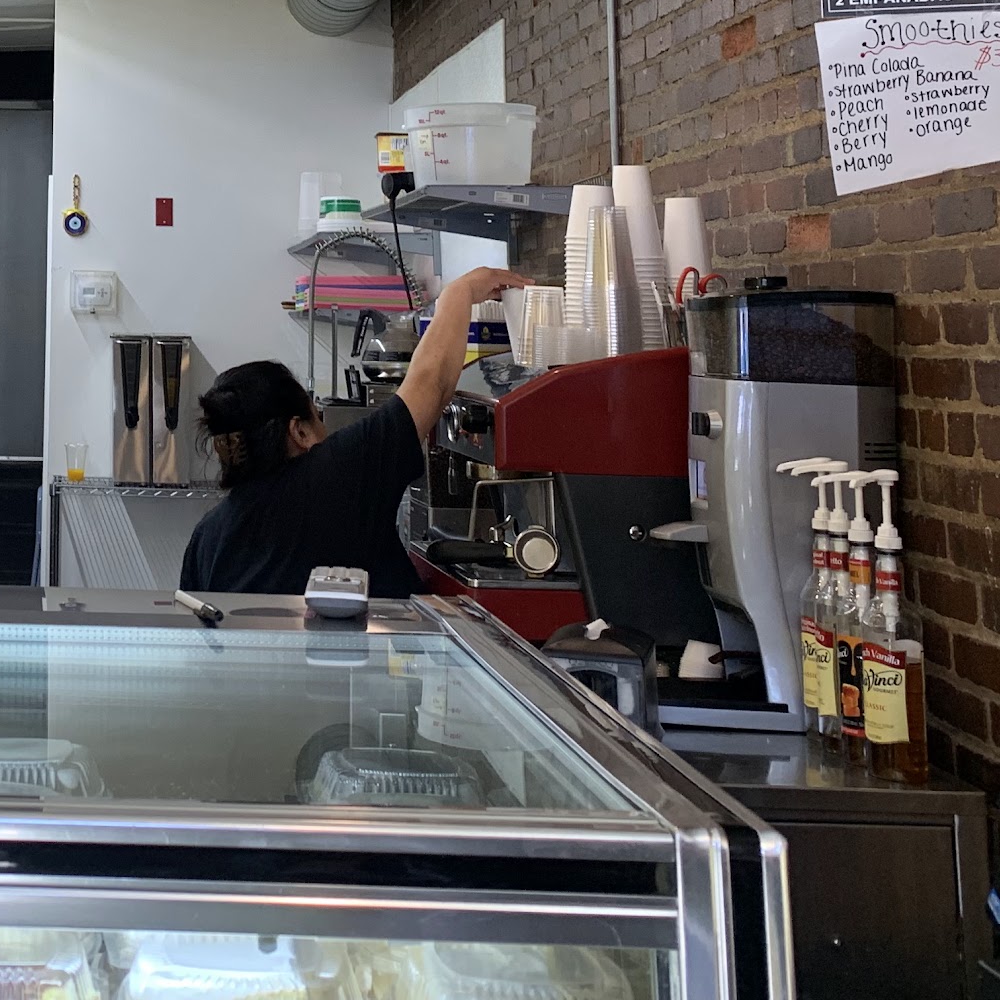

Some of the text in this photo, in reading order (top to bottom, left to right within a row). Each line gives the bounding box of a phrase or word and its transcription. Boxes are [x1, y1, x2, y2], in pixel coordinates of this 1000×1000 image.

[872, 56, 925, 75] Colada
[916, 69, 978, 86] Banana
[842, 131, 887, 154] Berry
[844, 153, 893, 172] Mango
[871, 649, 900, 666] Vanilla
